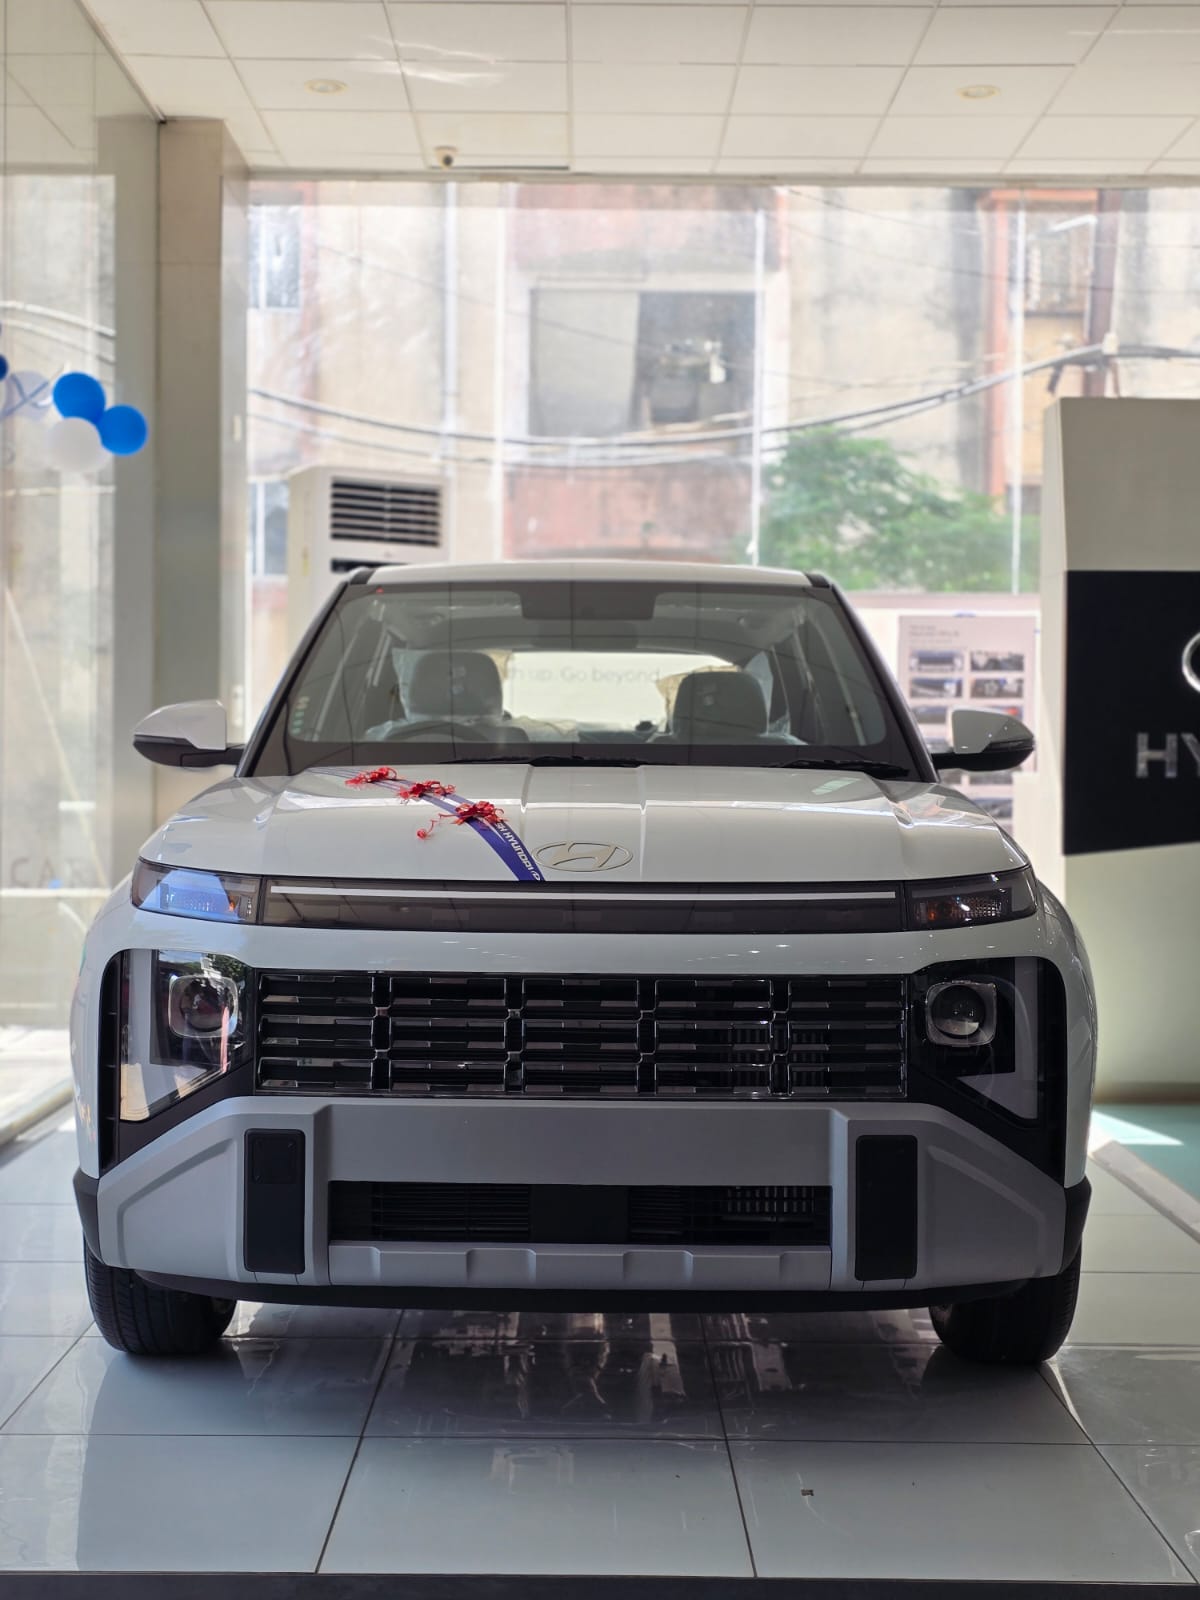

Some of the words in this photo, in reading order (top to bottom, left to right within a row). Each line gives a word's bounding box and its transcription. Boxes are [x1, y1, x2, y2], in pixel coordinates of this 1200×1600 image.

[560, 665, 588, 682] Go
[592, 666, 660, 685] beyond
[502, 831, 535, 871] HYUNDAI
